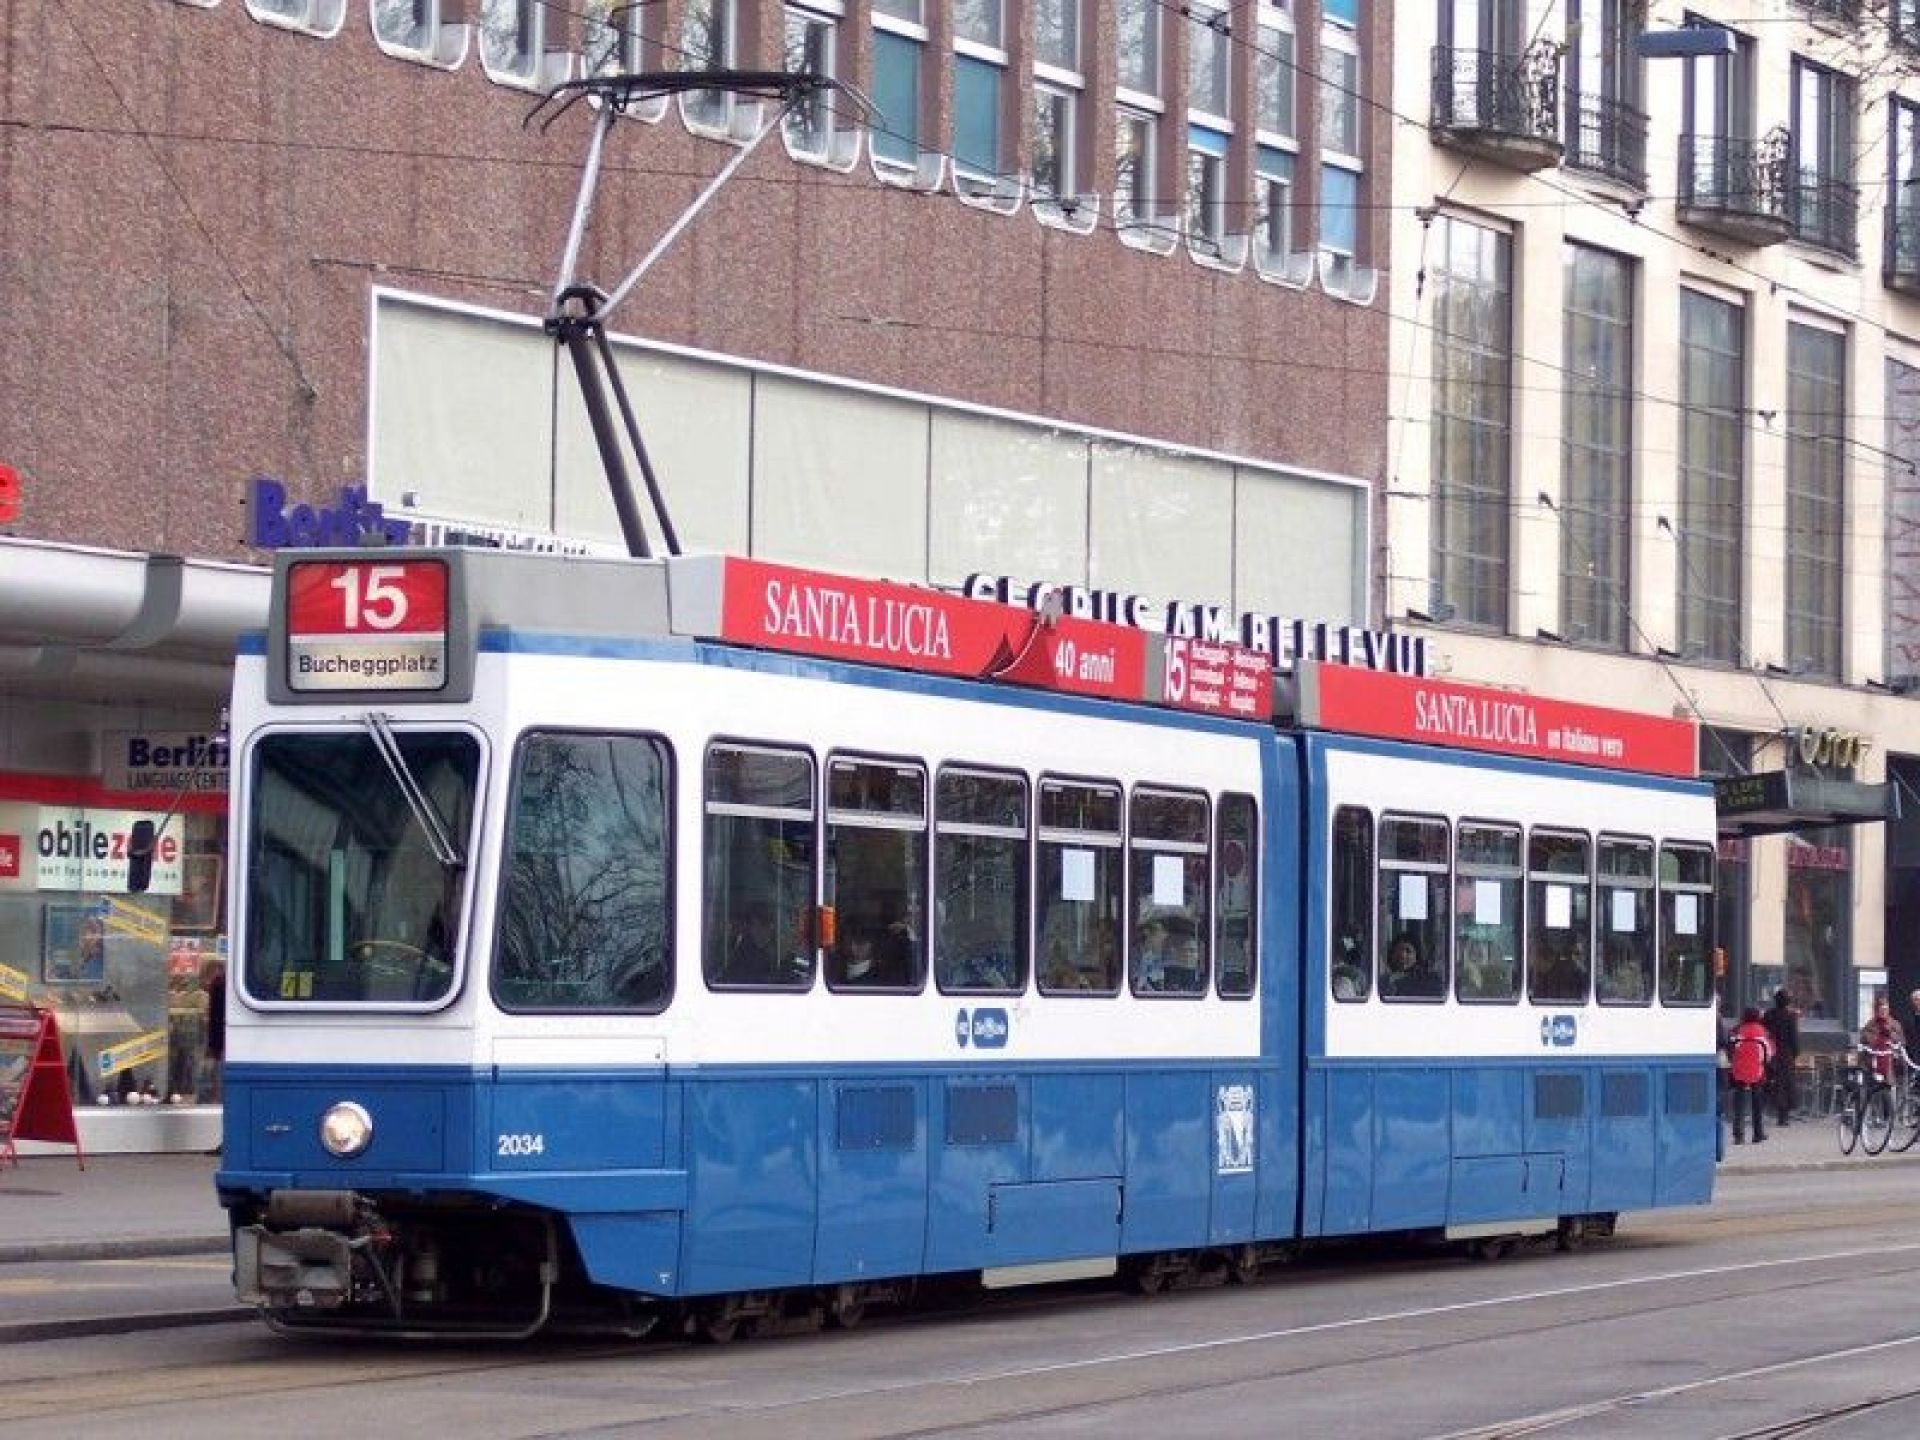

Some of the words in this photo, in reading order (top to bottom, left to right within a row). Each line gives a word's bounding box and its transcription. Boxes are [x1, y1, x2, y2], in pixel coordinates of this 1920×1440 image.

[330, 566, 409, 630] 15
[765, 579, 860, 645] SANTA
[866, 596, 951, 659] LUCIA
[299, 655, 438, 676] Bucheggplatz
[1055, 638, 1075, 678] 40
[1079, 646, 1115, 683] anni
[1164, 637, 1187, 702] 15
[1415, 690, 1478, 738] SANTA
[1481, 699, 1537, 745] LUCIA
[38, 820, 177, 863] obileze
[498, 1134, 543, 1155] 2034
